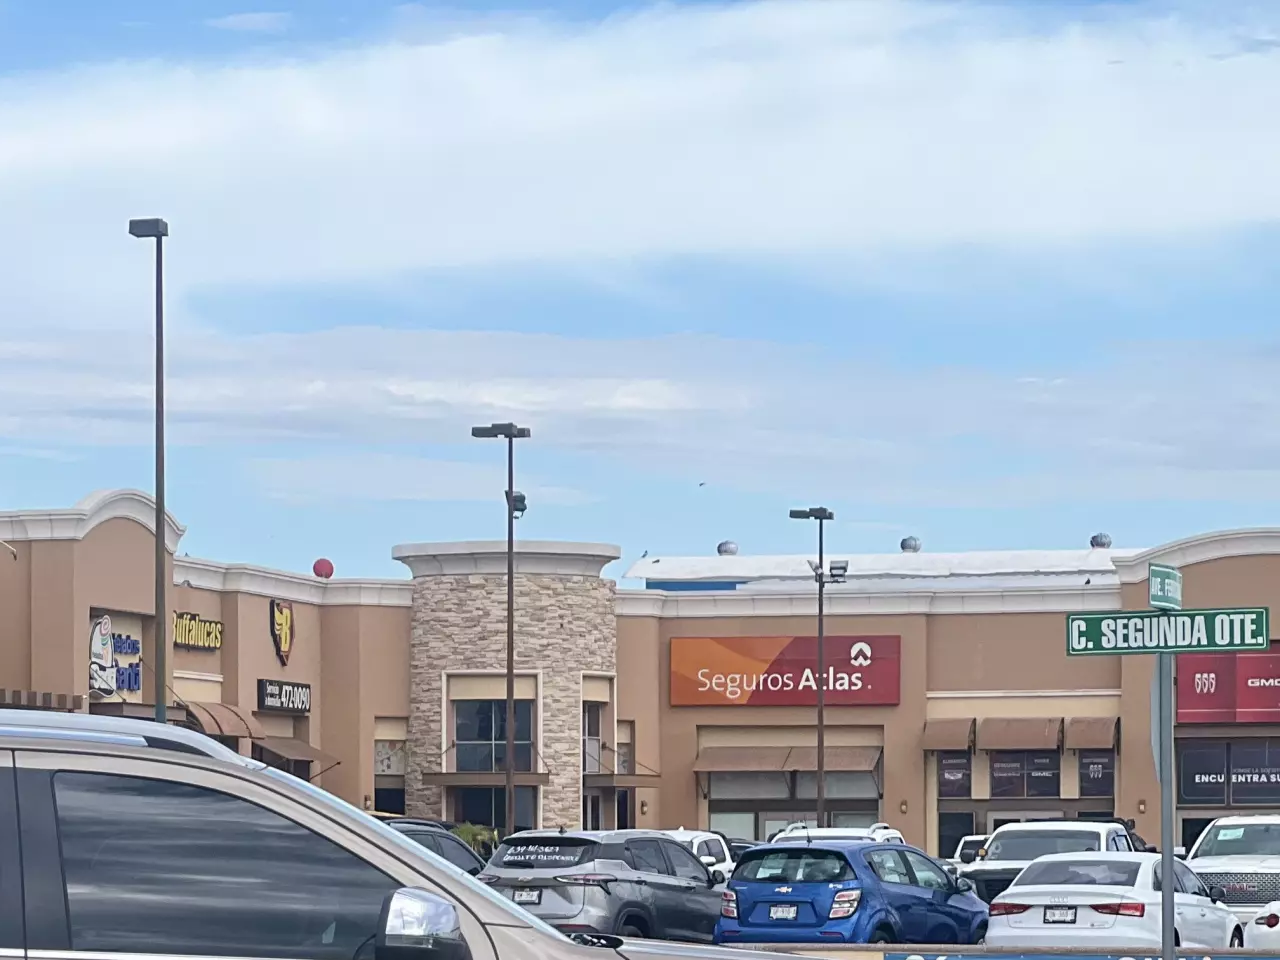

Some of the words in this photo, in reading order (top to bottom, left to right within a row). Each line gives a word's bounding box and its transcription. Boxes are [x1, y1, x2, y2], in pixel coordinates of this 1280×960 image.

[1071, 619, 1094, 650] C.
[1101, 615, 1208, 648] SEGUNDA
[1214, 613, 1264, 645] OTE.
[281, 685, 310, 710] 472-0090
[697, 668, 794, 699] Seguros
